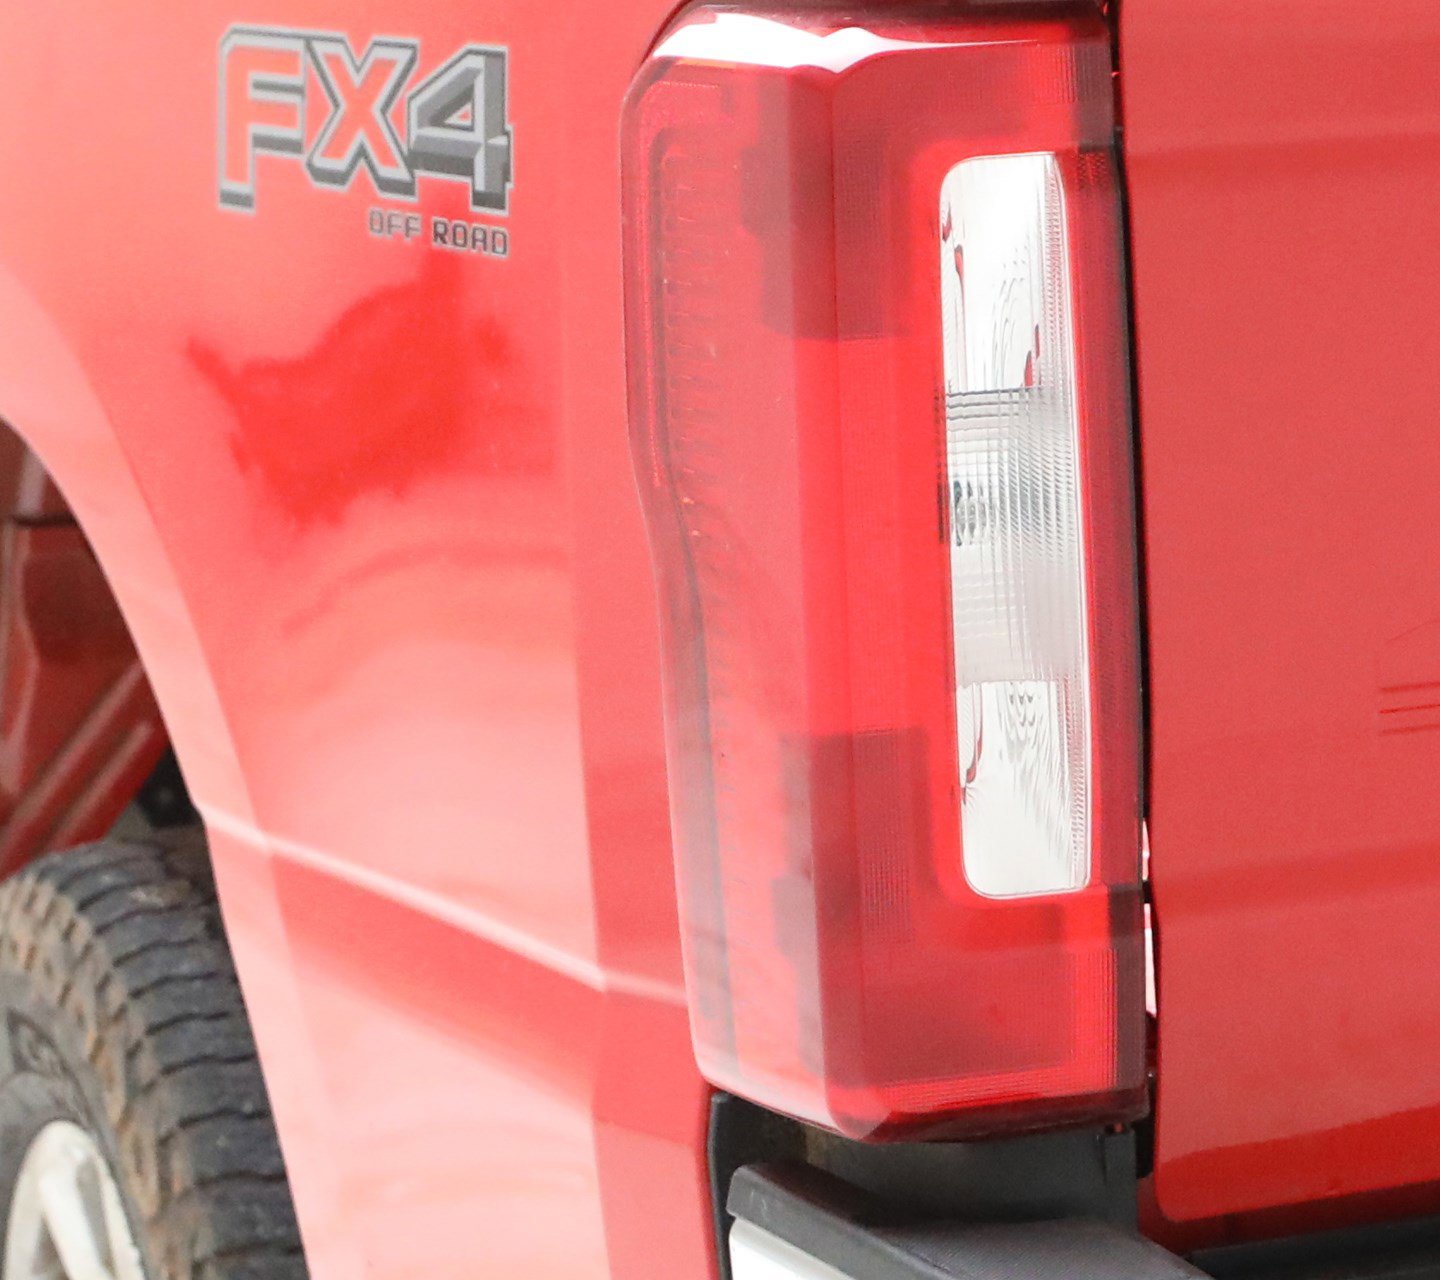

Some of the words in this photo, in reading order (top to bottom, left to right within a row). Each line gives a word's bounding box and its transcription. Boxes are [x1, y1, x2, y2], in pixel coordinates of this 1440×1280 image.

[218, 22, 513, 214] FX4
[368, 207, 422, 240] OFF
[431, 217, 509, 259] ROAD
